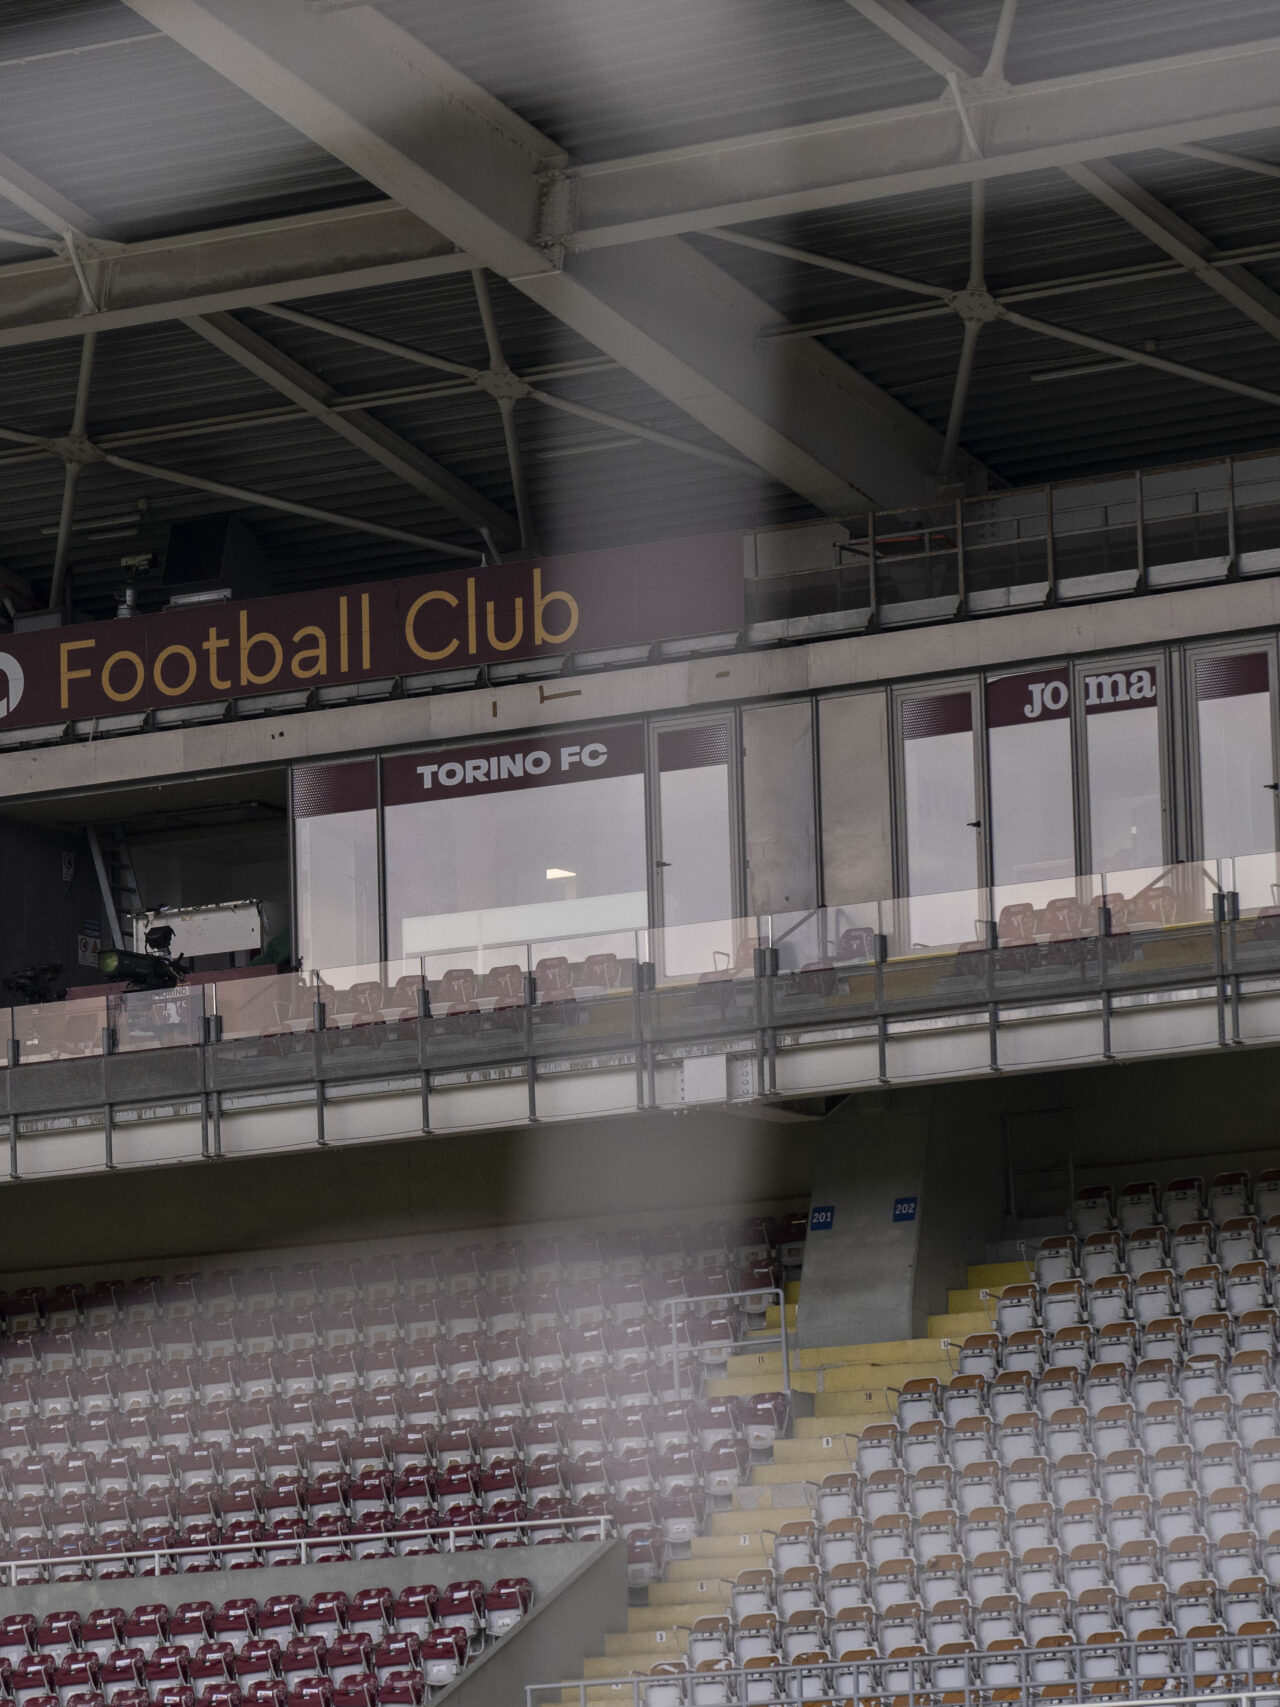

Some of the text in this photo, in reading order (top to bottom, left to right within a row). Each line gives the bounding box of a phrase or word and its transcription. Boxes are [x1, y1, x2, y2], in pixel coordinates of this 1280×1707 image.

[59, 592, 371, 709] Football
[404, 567, 580, 661] Club
[416, 743, 608, 789] TORINO FC
[812, 1211, 832, 1223] 201
[894, 1203, 915, 1215] 202
